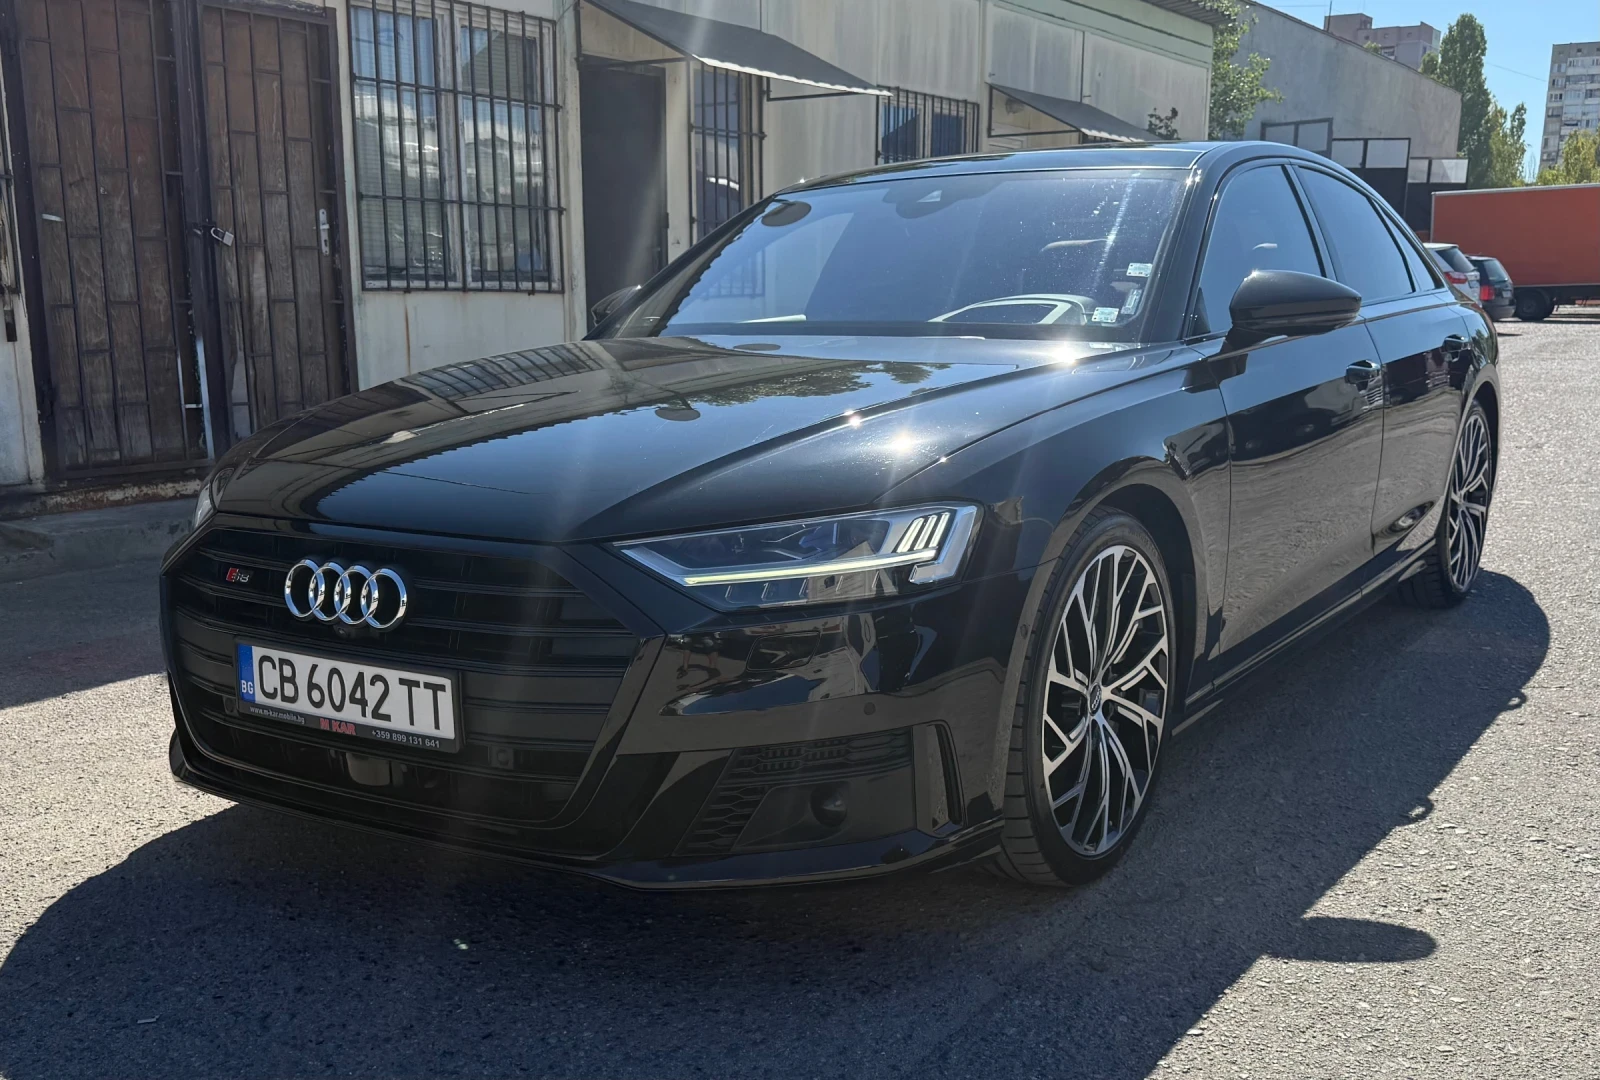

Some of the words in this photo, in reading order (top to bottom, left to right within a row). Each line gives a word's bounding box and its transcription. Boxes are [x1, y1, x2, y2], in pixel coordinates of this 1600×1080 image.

[241, 679, 254, 694] BG
[258, 655, 299, 704] CB
[307, 663, 392, 722] 6042
[398, 677, 446, 730] TT
[250, 706, 305, 725] www.m-kar.mobile.bg
[332, 719, 357, 735] KAR
[371, 730, 391, 740] +359
[392, 732, 407, 743] 899
[408, 735, 423, 746] 131
[425, 738, 440, 749] 641
